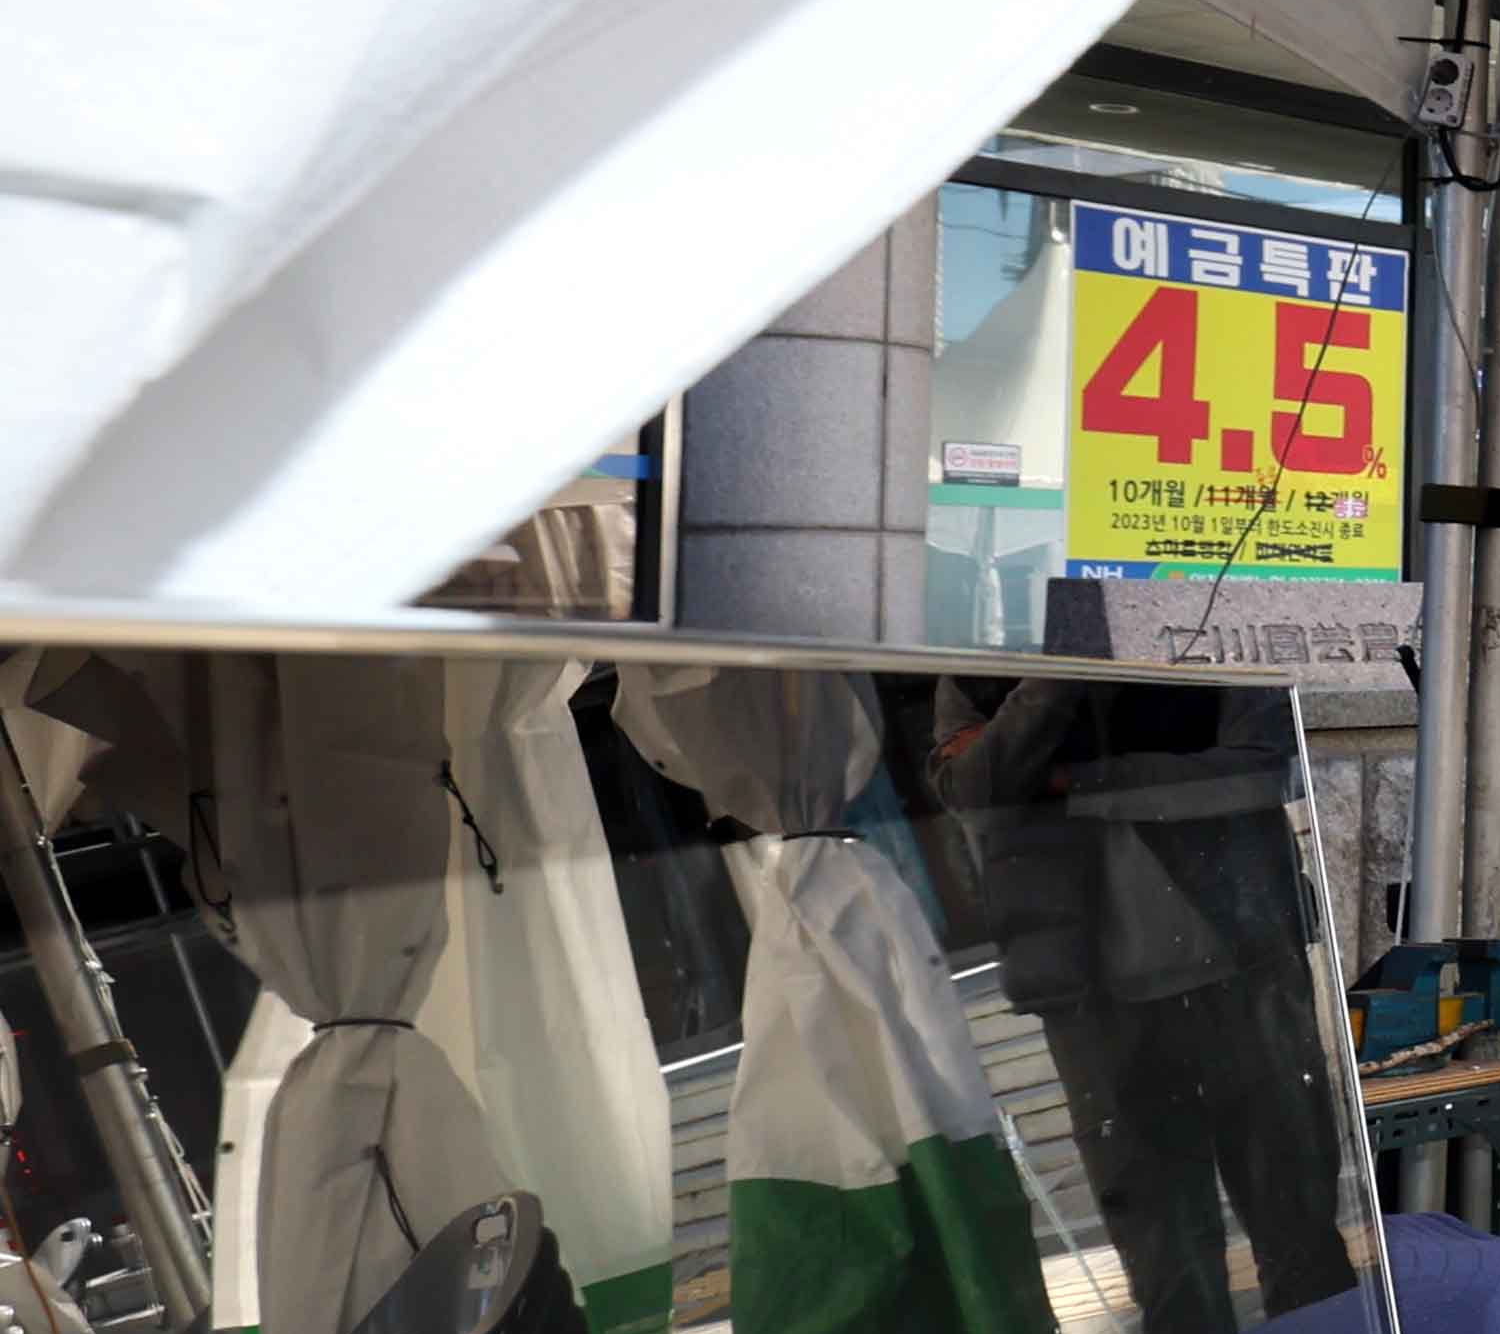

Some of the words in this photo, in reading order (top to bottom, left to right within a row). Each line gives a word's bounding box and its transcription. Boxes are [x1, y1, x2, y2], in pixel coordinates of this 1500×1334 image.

[1112, 217, 1377, 306] 예금특판
[1109, 479, 1185, 507] 10개월
[1111, 513, 1167, 532] 2023년
[1172, 515, 1205, 534] 10월
